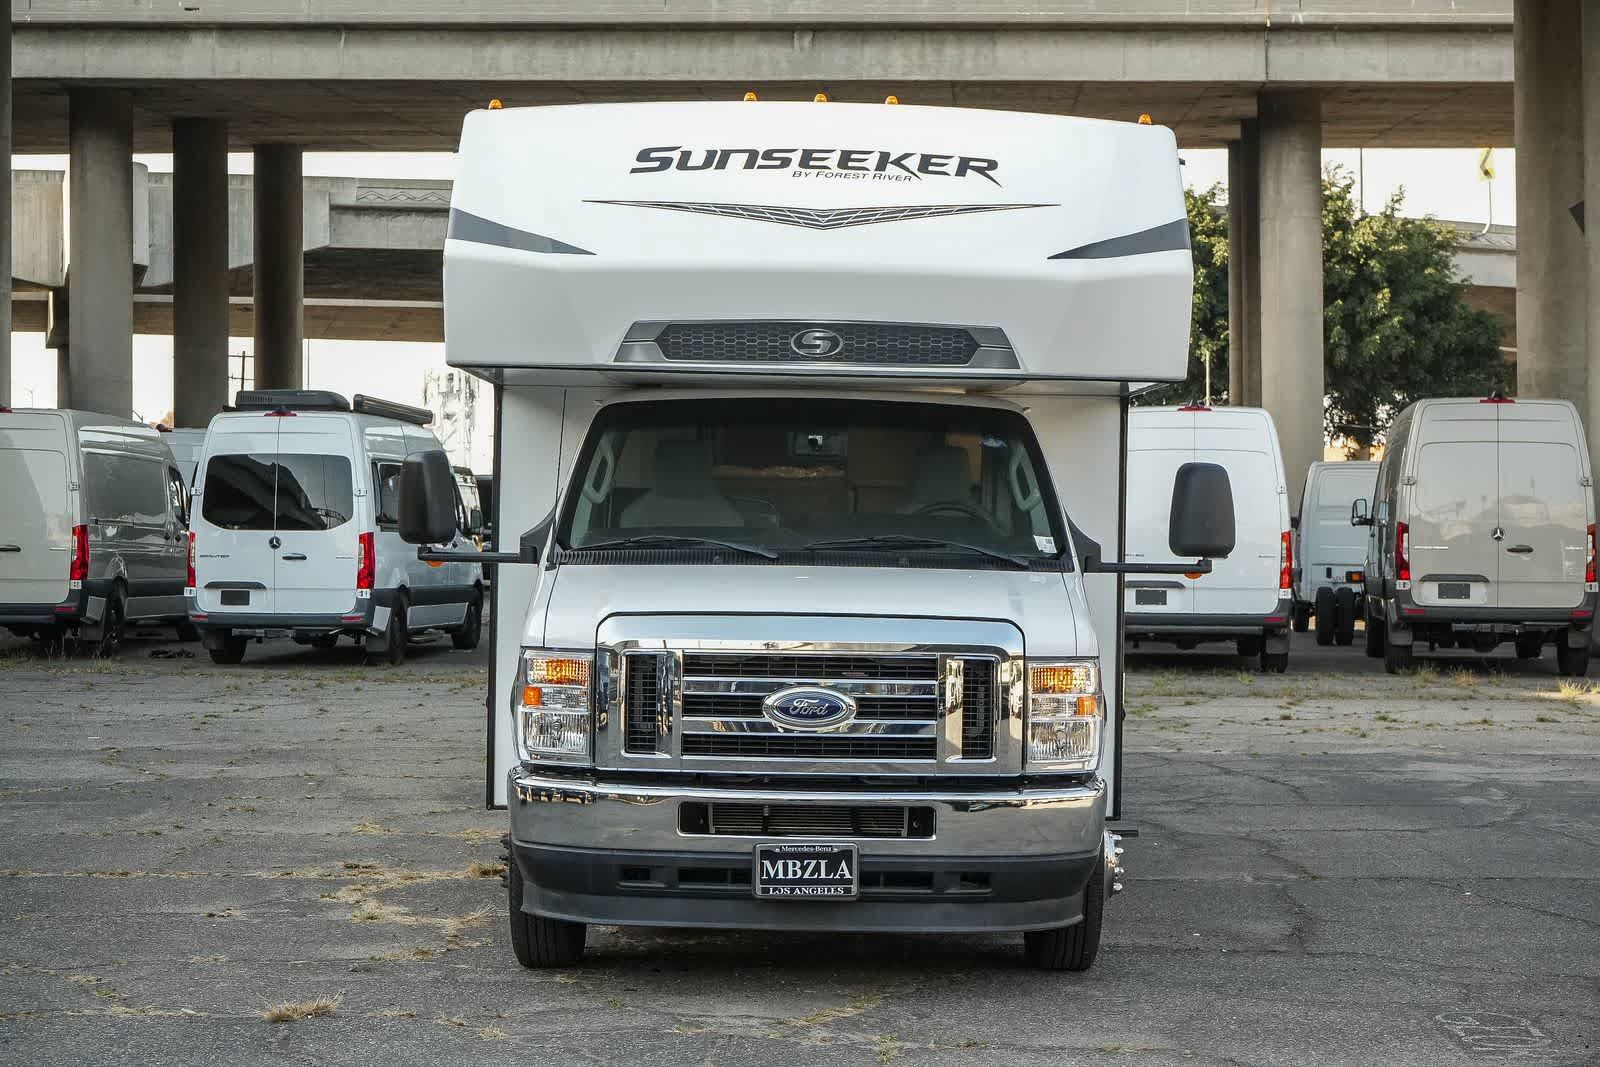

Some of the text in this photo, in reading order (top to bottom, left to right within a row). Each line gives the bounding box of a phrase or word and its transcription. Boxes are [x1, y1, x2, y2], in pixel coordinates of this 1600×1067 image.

[629, 145, 1003, 187] SUNSEEKER
[792, 170, 912, 182] BY FOREST RIVER
[789, 698, 829, 716] Ford
[761, 859, 853, 879] MBZLA
[769, 887, 844, 895] LOS ANGELES
